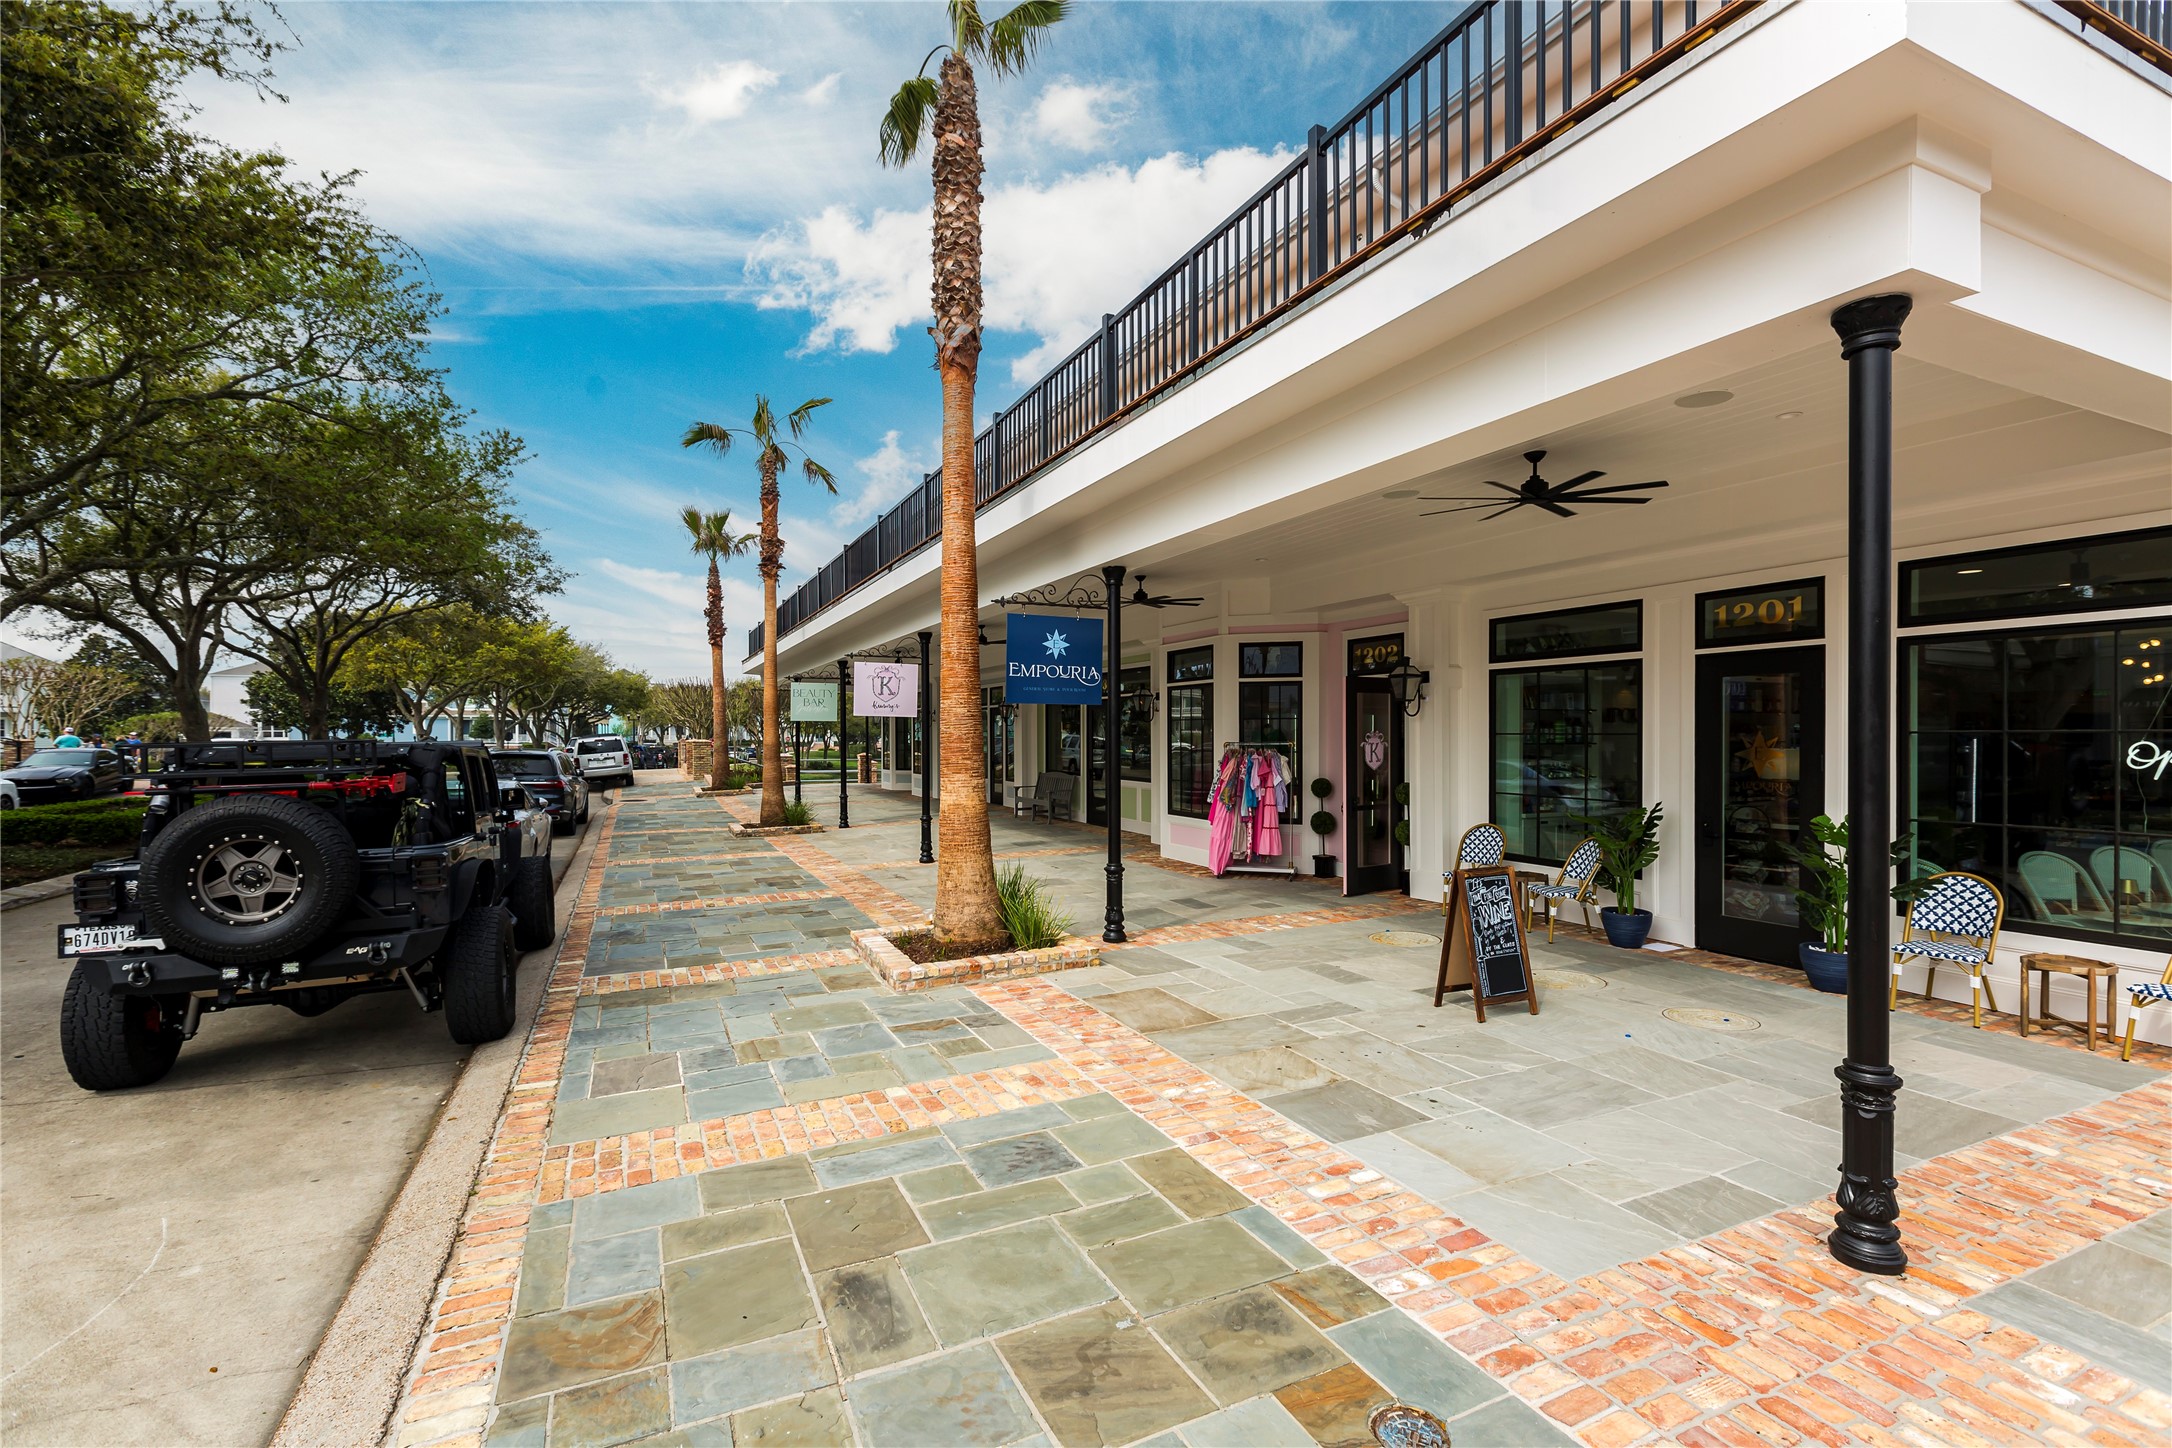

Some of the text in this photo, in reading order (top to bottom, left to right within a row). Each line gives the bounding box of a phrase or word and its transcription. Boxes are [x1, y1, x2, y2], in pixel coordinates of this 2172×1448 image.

[1714, 596, 1802, 628] 1201
[1009, 662, 1101, 687] EMPOURIA
[793, 689, 836, 698] BEAUTY
[877, 676, 896, 695] K
[803, 698, 826, 708] BAR
[1368, 742, 1381, 762] K
[1478, 901, 1512, 928] WINE
